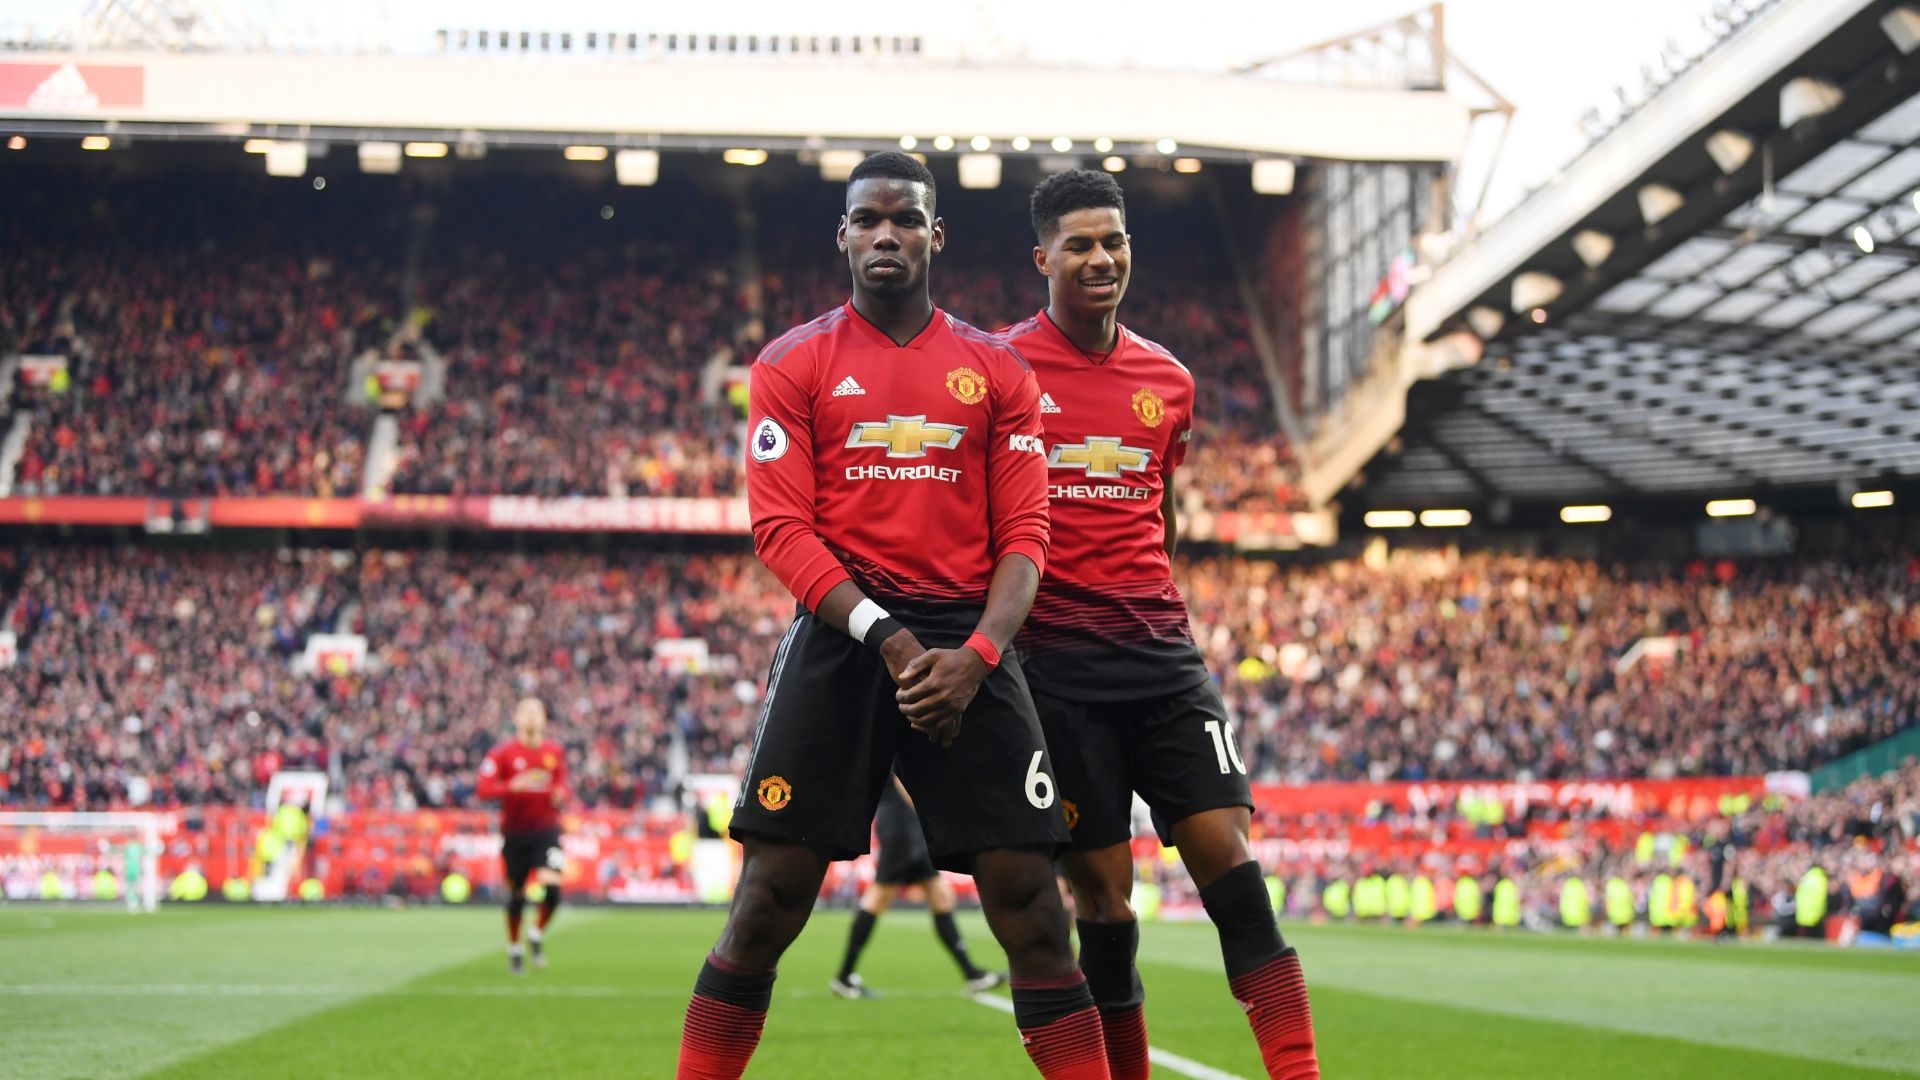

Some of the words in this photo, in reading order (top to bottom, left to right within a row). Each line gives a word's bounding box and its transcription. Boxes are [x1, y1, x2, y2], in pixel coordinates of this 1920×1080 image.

[832, 387, 866, 397] adidas
[1041, 405, 1062, 414] idas
[845, 465, 962, 483] CHEVROLET
[1048, 485, 1151, 500] CHEVROLET
[1205, 720, 1247, 775] 10
[1025, 751, 1055, 809] 6
